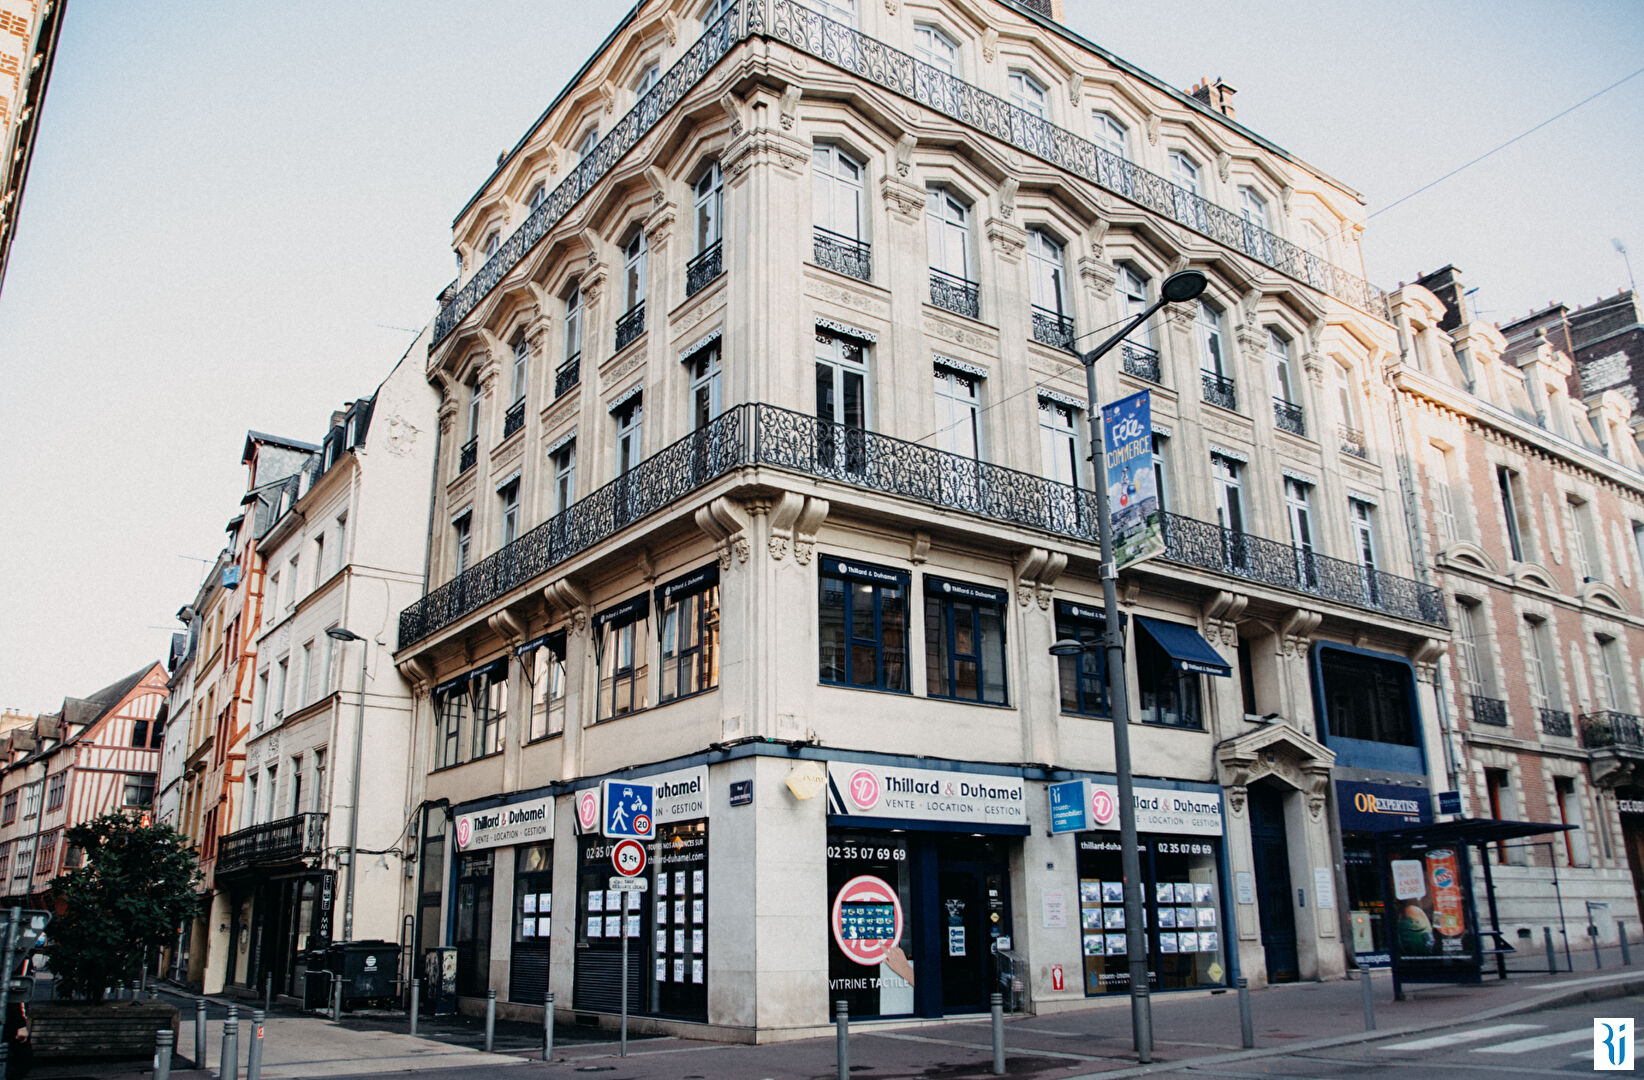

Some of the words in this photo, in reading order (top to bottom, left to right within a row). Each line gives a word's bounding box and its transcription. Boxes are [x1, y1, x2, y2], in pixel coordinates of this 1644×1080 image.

[1107, 434, 1151, 469] COMMERCE
[848, 566, 867, 576] Thillard
[874, 571, 897, 581] Duhamel
[952, 586, 970, 595] Thillard
[975, 590, 997, 600] Duhamel
[656, 775, 701, 799] uhamel
[885, 776, 940, 795] Thillard
[944, 782, 955, 797] &
[960, 782, 1022, 801] Duhamel
[671, 801, 703, 815] GESTION
[885, 799, 916, 810] VENTE
[927, 801, 974, 814] LOCATION
[984, 805, 1021, 816] GESTION
[1161, 799, 1170, 811] &
[1174, 798, 1221, 815] Duhamel
[474, 813, 500, 831] Thillard
[501, 812, 507, 826] &
[509, 804, 546, 825] Duhamel
[637, 820, 647, 829] 20
[1149, 816, 1184, 826] LOCATION
[1192, 818, 1220, 828] GESTION
[475, 834, 489, 844] VENTE
[493, 830, 519, 841] LOCATION
[523, 826, 547, 837] GESTION
[586, 847, 595, 859] 02
[595, 846, 604, 858] 35
[827, 847, 841, 858] 02
[844, 847, 858, 859] 35
[861, 848, 874, 859] 07
[877, 848, 890, 860] 69
[893, 849, 906, 861] 69
[1158, 842, 1169, 853] 02
[1169, 843, 1179, 854] 35
[1180, 843, 1190, 854] 07
[1191, 844, 1201, 854] 69
[1202, 844, 1212, 855] 69
[829, 978, 868, 990] VITRINE
[870, 977, 911, 989] TACTILE
